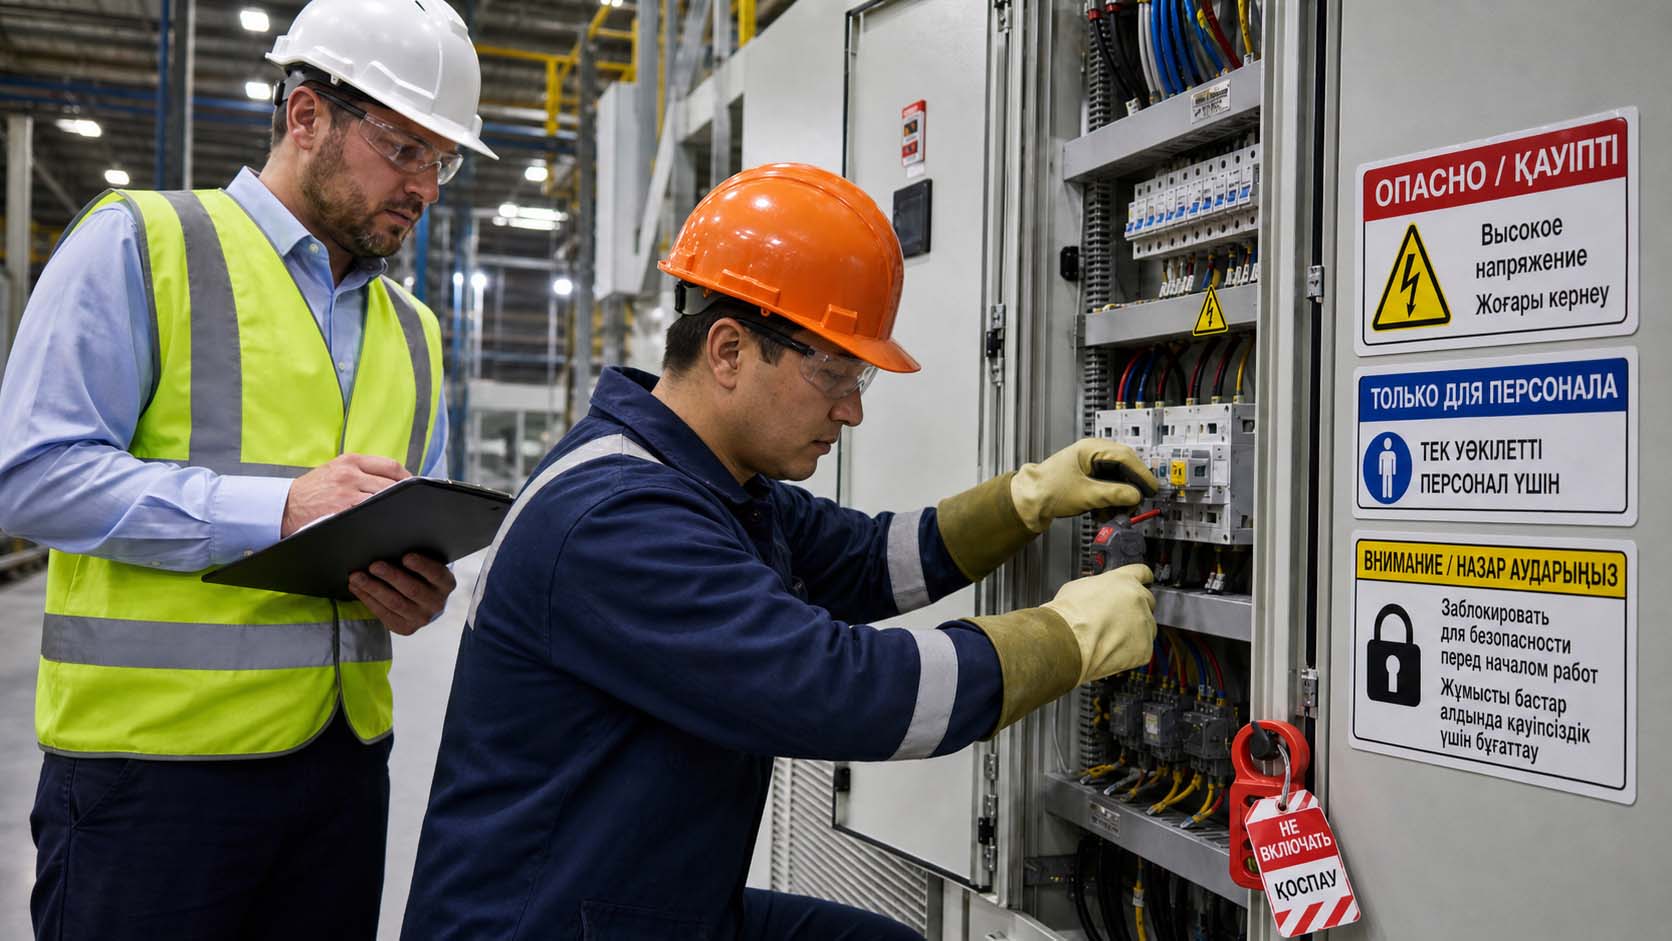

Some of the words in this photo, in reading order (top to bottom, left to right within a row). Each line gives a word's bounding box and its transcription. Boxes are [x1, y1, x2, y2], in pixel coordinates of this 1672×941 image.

[1375, 160, 1486, 207] ОПАСНО
[1494, 156, 1506, 186] /
[1514, 134, 1618, 186] ҚАУІПТІ
[1481, 217, 1563, 246] Высокое
[1475, 248, 1588, 280] напряжение
[1475, 291, 1543, 316] Жоғары
[1549, 285, 1610, 310] кернеу
[1371, 384, 1439, 410] ТОЛЬКО
[1443, 382, 1483, 411] ДЛЯ
[1489, 372, 1619, 404] ПЕРСОНАЛА
[1420, 441, 1450, 461] ТЕК
[1455, 438, 1542, 461] УӘКІЛЕТТІ
[1420, 473, 1508, 494] ПЕРСОНАЛ
[1514, 473, 1560, 494] ҮШІН
[1364, 550, 1443, 575] ВНИМАНИЕ
[1446, 554, 1453, 576] /
[1457, 556, 1506, 580] НАЗАР
[1510, 559, 1618, 588] АУДАРЫҢЫЗ
[1441, 598, 1549, 626] Заблокировать
[1441, 625, 1465, 643] для
[1470, 625, 1571, 654] безопасности
[1441, 650, 1481, 671] перед
[1485, 655, 1548, 678] началом
[1553, 662, 1598, 684] работ
[1440, 677, 1510, 705] Жұмысты
[1515, 689, 1567, 717] бастар
[1440, 706, 1502, 730] алдында
[1440, 728, 1471, 749] үшін
[1476, 731, 1539, 765] бұғаттау
[1279, 818, 1300, 837] НЕ
[1260, 833, 1331, 862] ВКЛЮЧАТЬ
[1274, 869, 1337, 901] ҚОСПАУ
